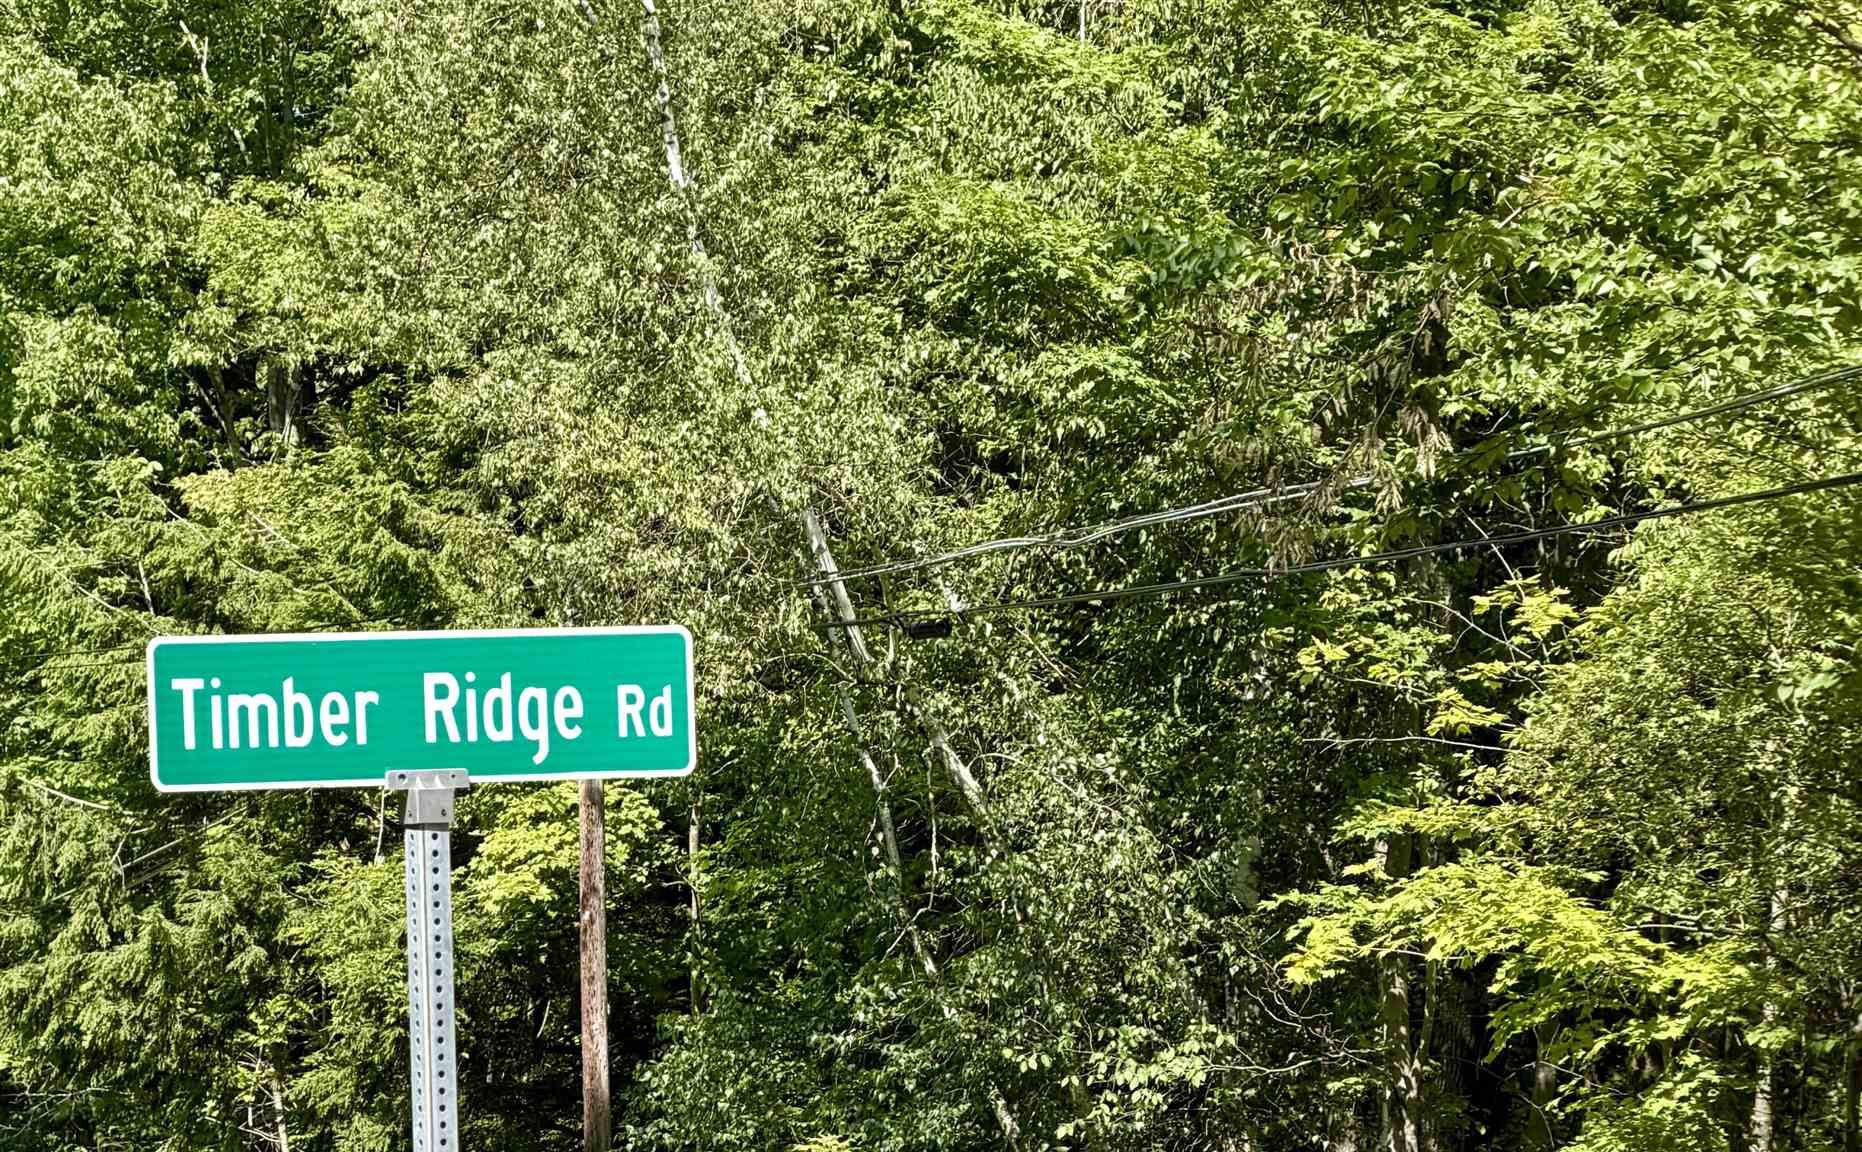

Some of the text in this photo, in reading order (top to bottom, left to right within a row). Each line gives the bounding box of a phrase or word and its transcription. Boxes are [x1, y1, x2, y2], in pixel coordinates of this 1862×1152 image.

[171, 671, 673, 765] Timber Ridge Rd
